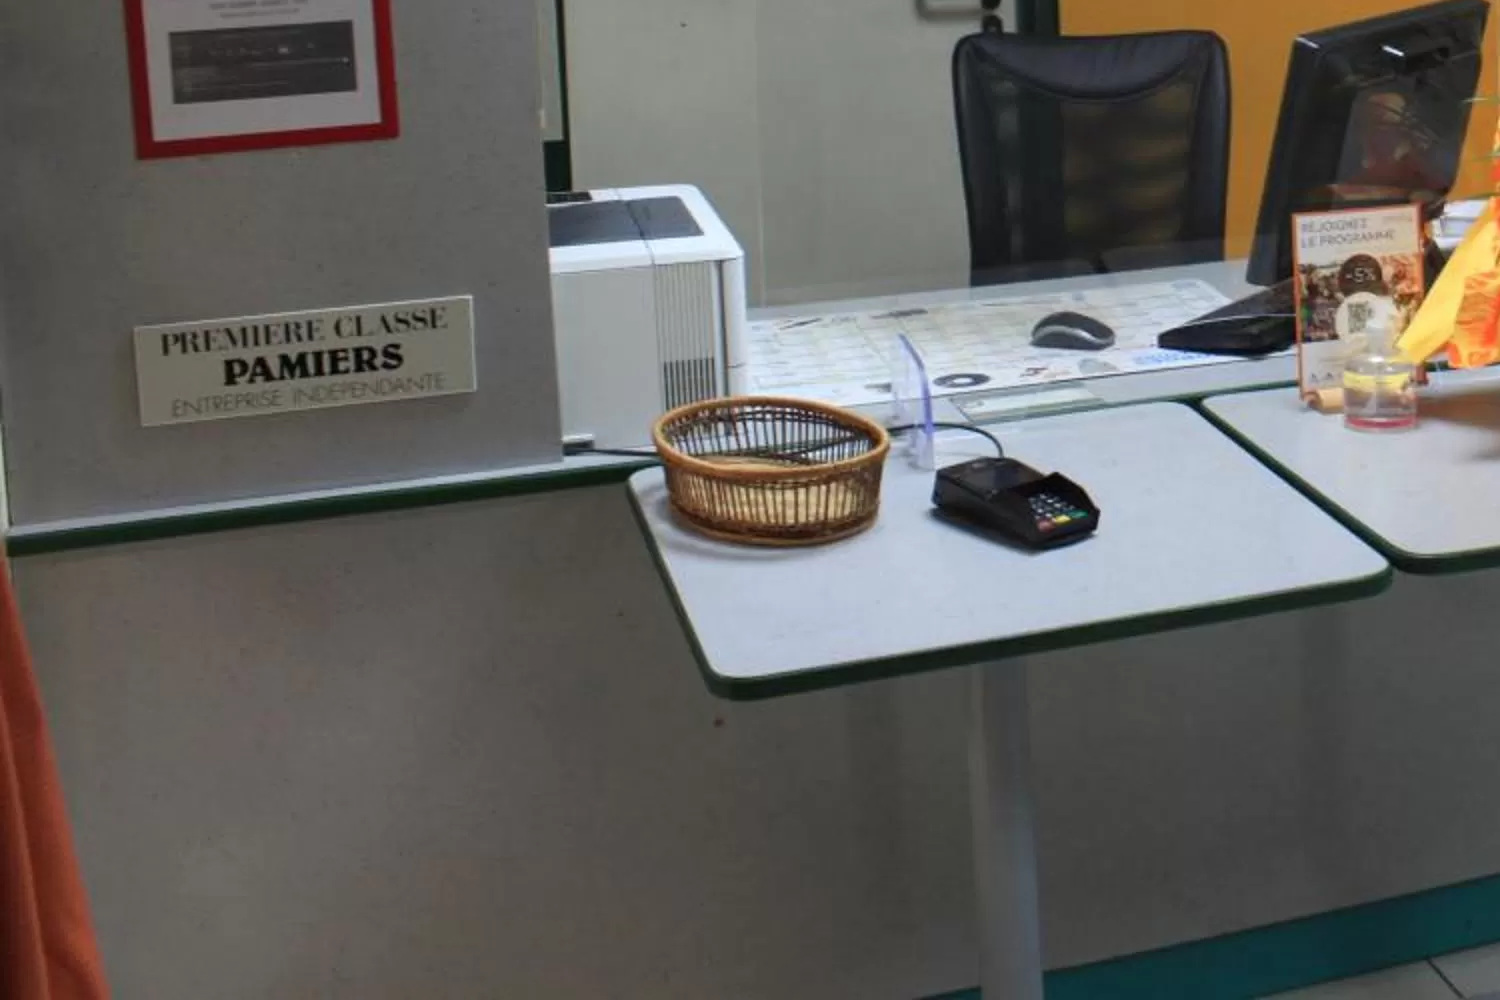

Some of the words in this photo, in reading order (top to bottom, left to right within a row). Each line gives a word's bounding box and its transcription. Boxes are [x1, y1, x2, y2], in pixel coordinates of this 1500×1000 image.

[160, 318, 326, 357] PREMIERE
[333, 306, 449, 341] CLASSE
[223, 343, 405, 387] PAMIERS
[171, 388, 284, 417] ENTREPRISE
